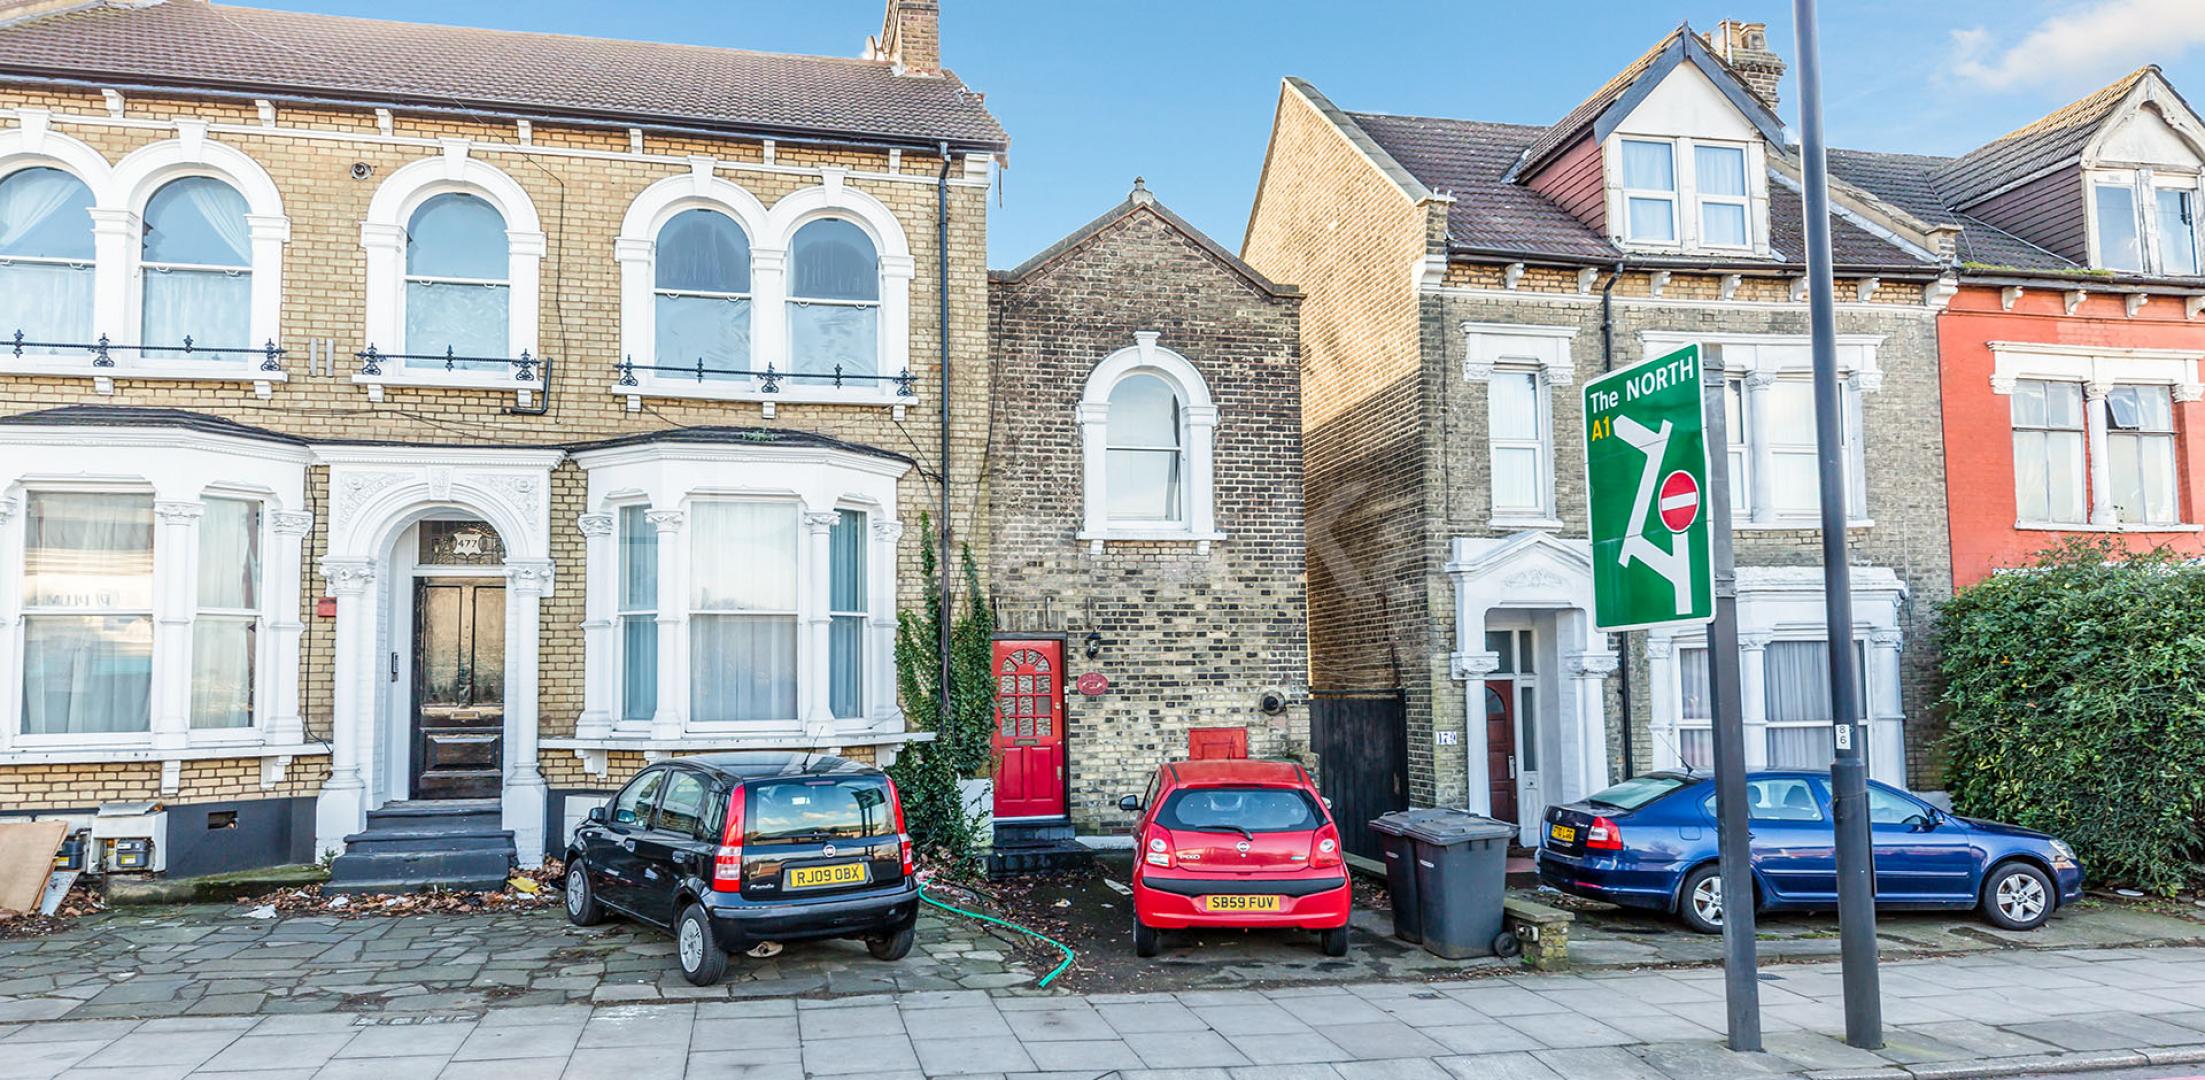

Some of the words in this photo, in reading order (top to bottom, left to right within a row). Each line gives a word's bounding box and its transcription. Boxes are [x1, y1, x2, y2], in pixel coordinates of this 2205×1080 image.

[1590, 389, 1619, 414] The
[1625, 355, 1695, 402] NORTH
[1591, 415, 1612, 442] A1
[457, 539, 477, 548] 477
[797, 869, 832, 885] RJ09
[835, 865, 860, 880] OBX
[1212, 896, 1246, 909] SB59
[1249, 896, 1274, 909] FUV
